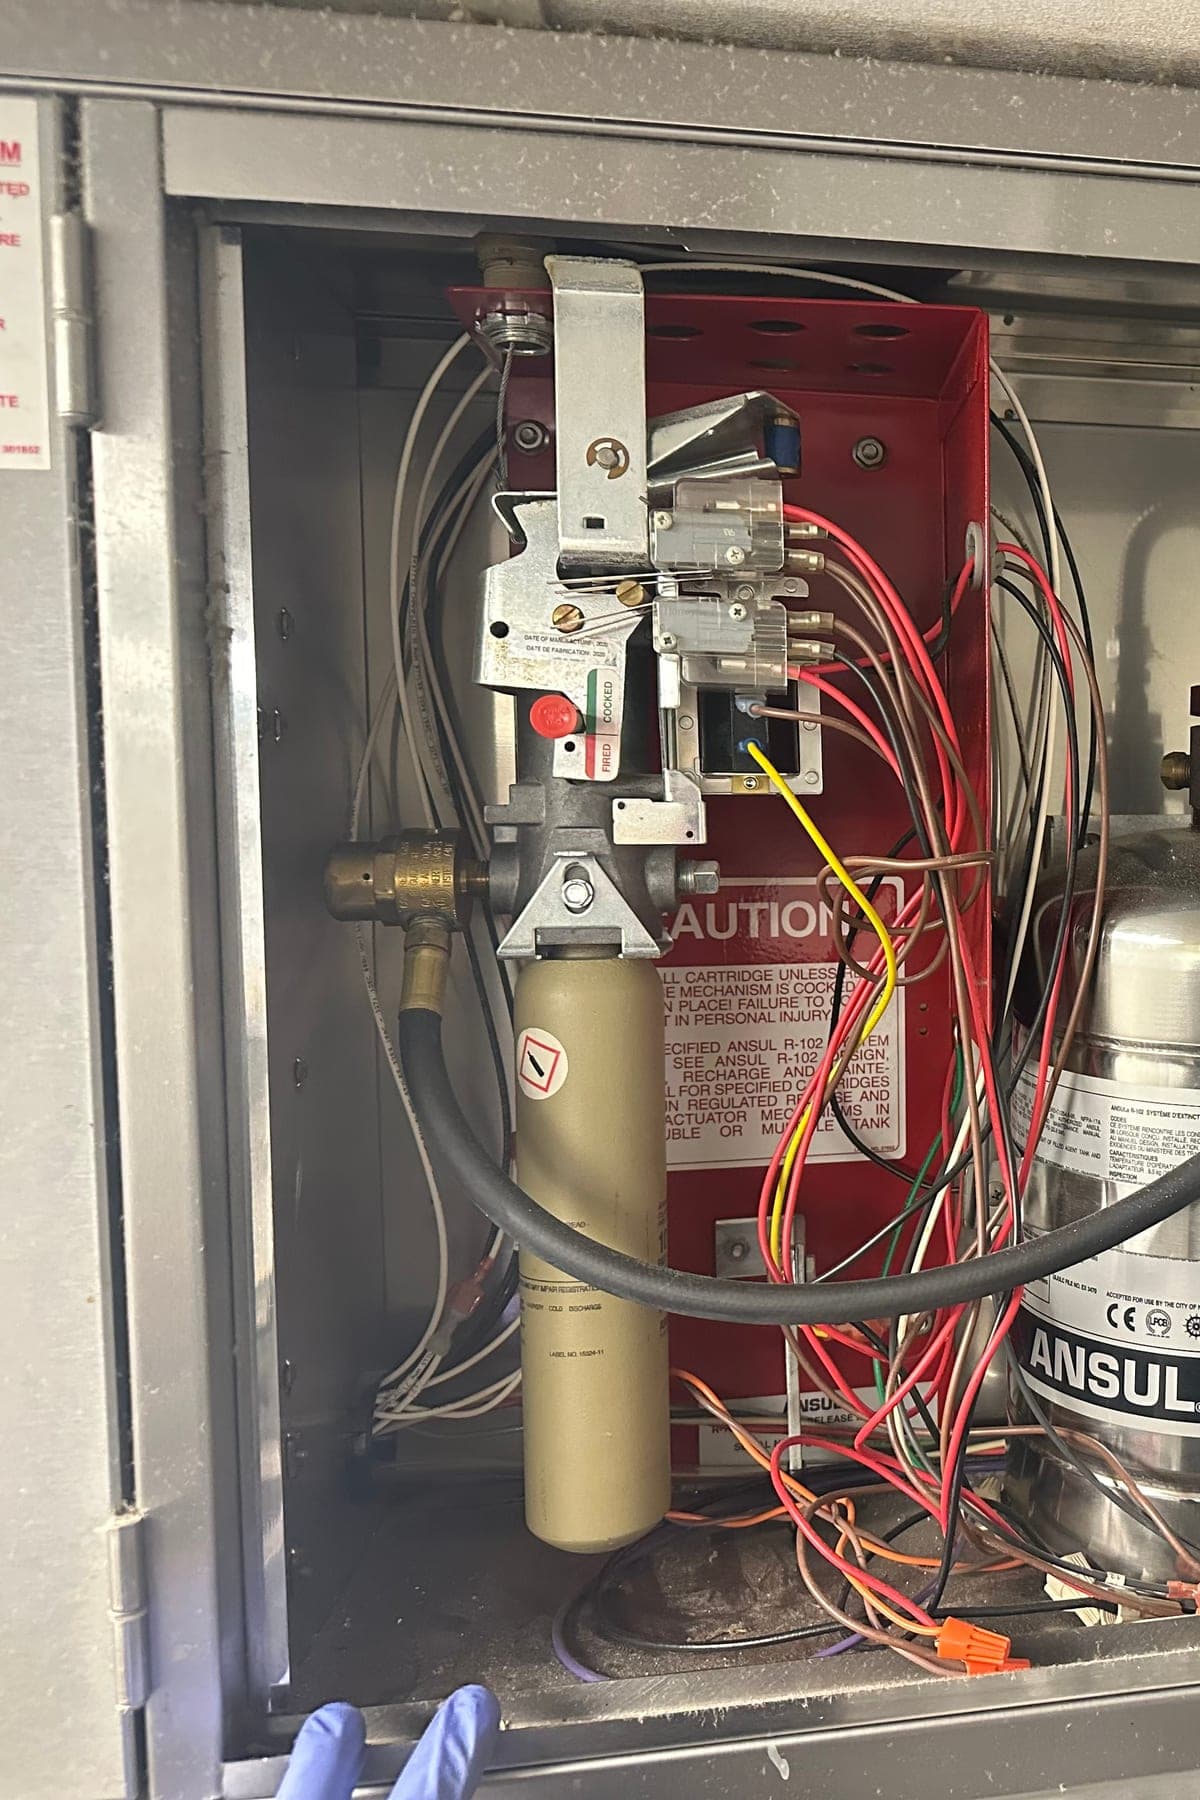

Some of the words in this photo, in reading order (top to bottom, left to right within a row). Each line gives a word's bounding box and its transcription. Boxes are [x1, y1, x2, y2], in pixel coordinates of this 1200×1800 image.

[602, 680, 613, 724] COCKED
[601, 743, 612, 773] FIRED
[661, 901, 850, 940] AUTION
[685, 969, 774, 985] CARTRIDGE
[778, 967, 837, 982] UNLESS
[680, 983, 772, 998] MECHANISM
[776, 982, 790, 995] IS
[679, 998, 732, 1012] PLACE!
[738, 996, 799, 1010] FAILURE
[802, 995, 825, 1008] TO
[675, 1014, 690, 1027] IN
[694, 1012, 776, 1026] PERSONAL
[779, 1009, 832, 1024] INJURY
[664, 1041, 721, 1056] ECIFIED
[727, 1039, 777, 1053] ANSUL
[784, 1037, 824, 1051] R-102
[673, 1056, 705, 1070] SEE
[715, 1053, 767, 1068] ANSUL
[777, 1051, 818, 1065] R-102
[683, 1067, 771, 1083] RECHARGE
[783, 1065, 816, 1079] AND
[843, 1062, 890, 1076] AINTE-
[679, 1084, 711, 1097] FOR
[714, 1080, 792, 1096] SPECIFIED
[796, 1075, 890, 1092] CRIDGES
[687, 1095, 778, 1111] REGULATED
[859, 1089, 890, 1102] AND
[664, 1110, 747, 1126] ACTUATOR
[876, 1103, 890, 1115] IN
[665, 1126, 702, 1141] UBLE
[719, 1124, 743, 1138] OR
[851, 1116, 891, 1130] TANK
[1106, 1291, 1132, 1302] ACCEPTED
[1132, 1296, 1143, 1304] FOR
[1144, 1298, 1155, 1306] USE
[1175, 1302, 1188, 1310] CITY
[1150, 1317, 1168, 1327] LPCB
[1029, 1326, 1195, 1413] ANSUL
